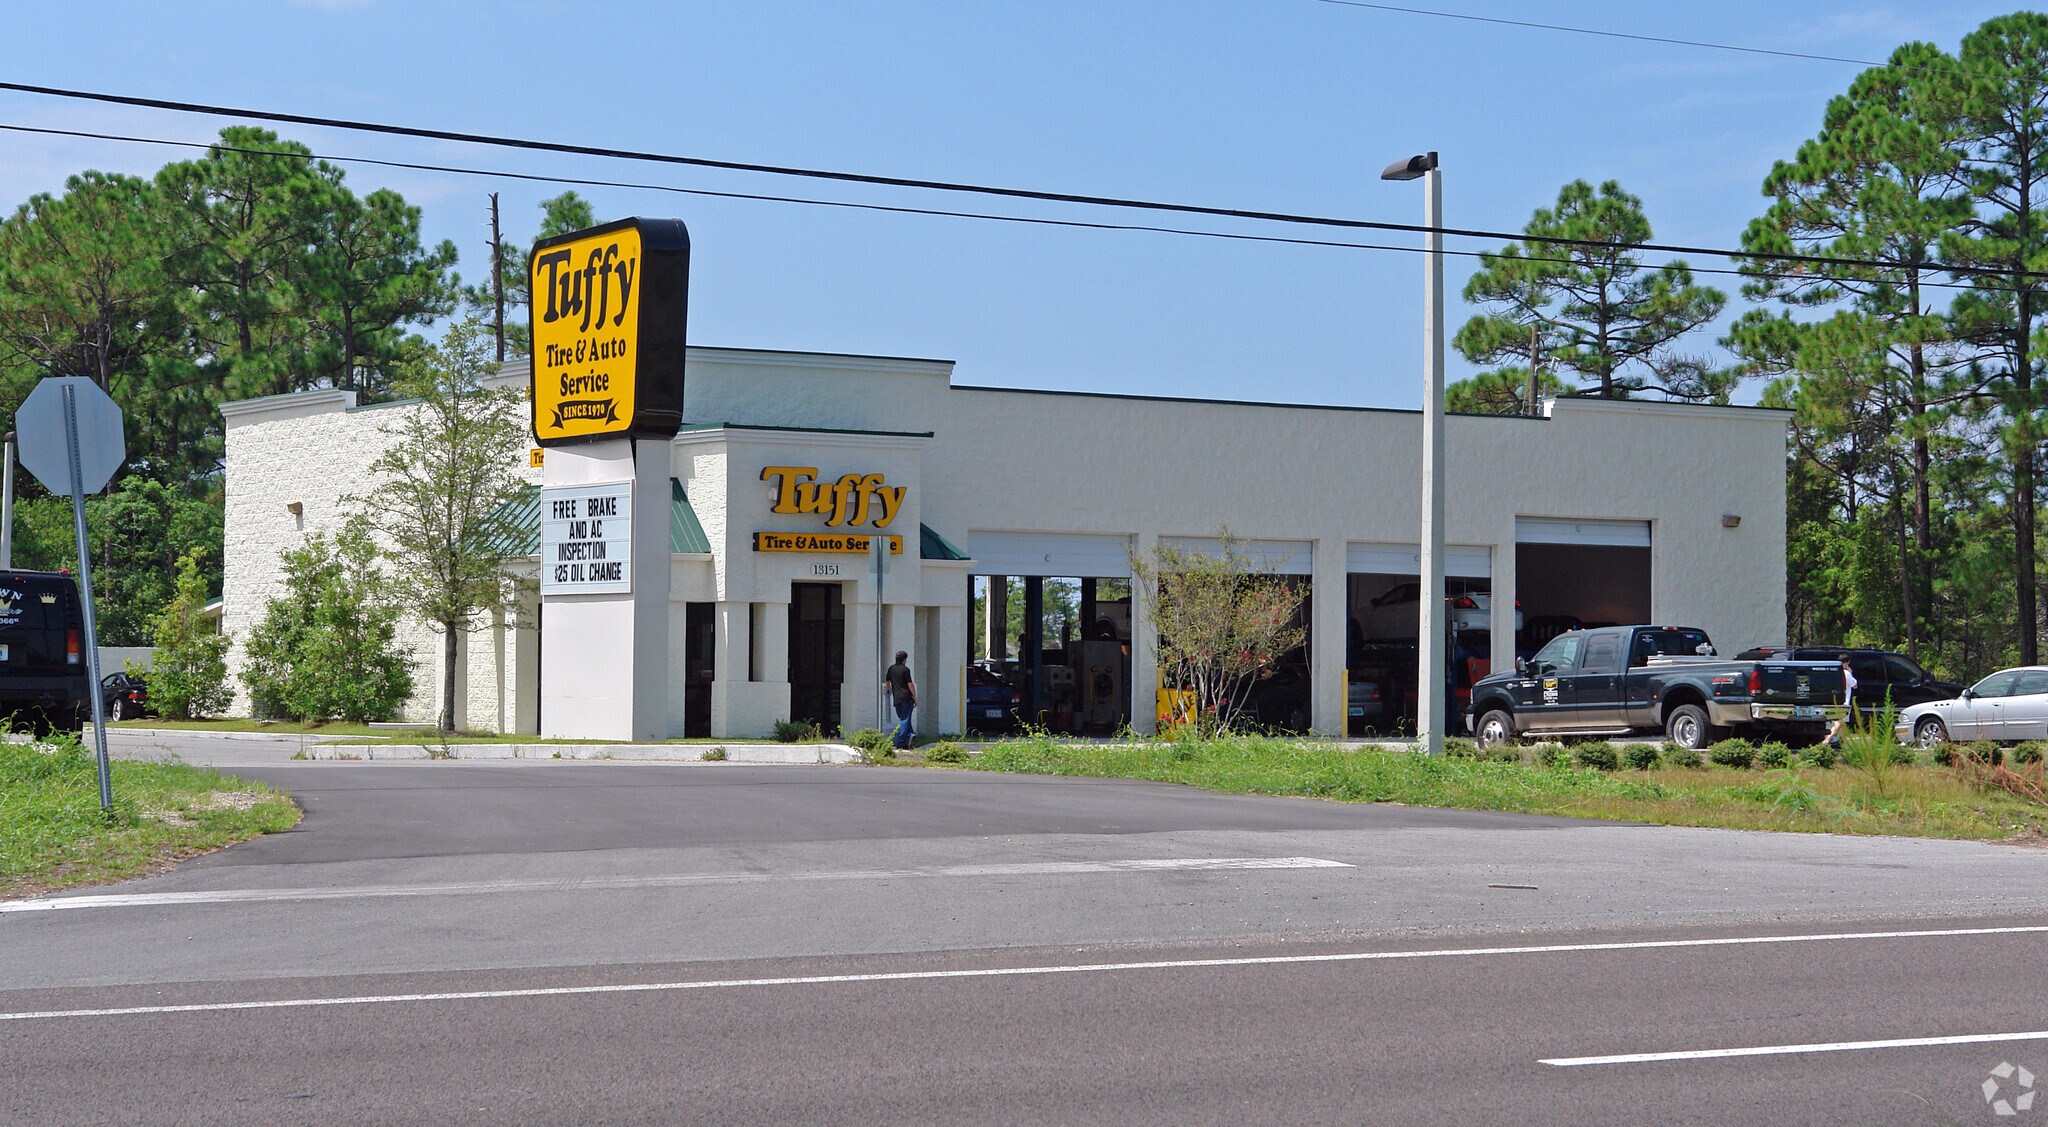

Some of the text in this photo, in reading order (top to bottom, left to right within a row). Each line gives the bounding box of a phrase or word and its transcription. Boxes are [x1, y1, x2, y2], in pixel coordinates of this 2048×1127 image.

[537, 243, 636, 333] Tuffy
[546, 337, 627, 367] Tire & Auto
[560, 369, 609, 397] Service
[563, 403, 605, 418] SINCE 1970
[760, 466, 907, 528] Tuffy
[553, 497, 616, 519] FREE BRAKE
[569, 520, 602, 539] AND AC
[558, 541, 606, 561] INSPECTION
[765, 536, 897, 550] Tire & Auto Sere
[554, 562, 621, 583] $25 OIL CHANGE
[814, 565, 839, 575] 13151
